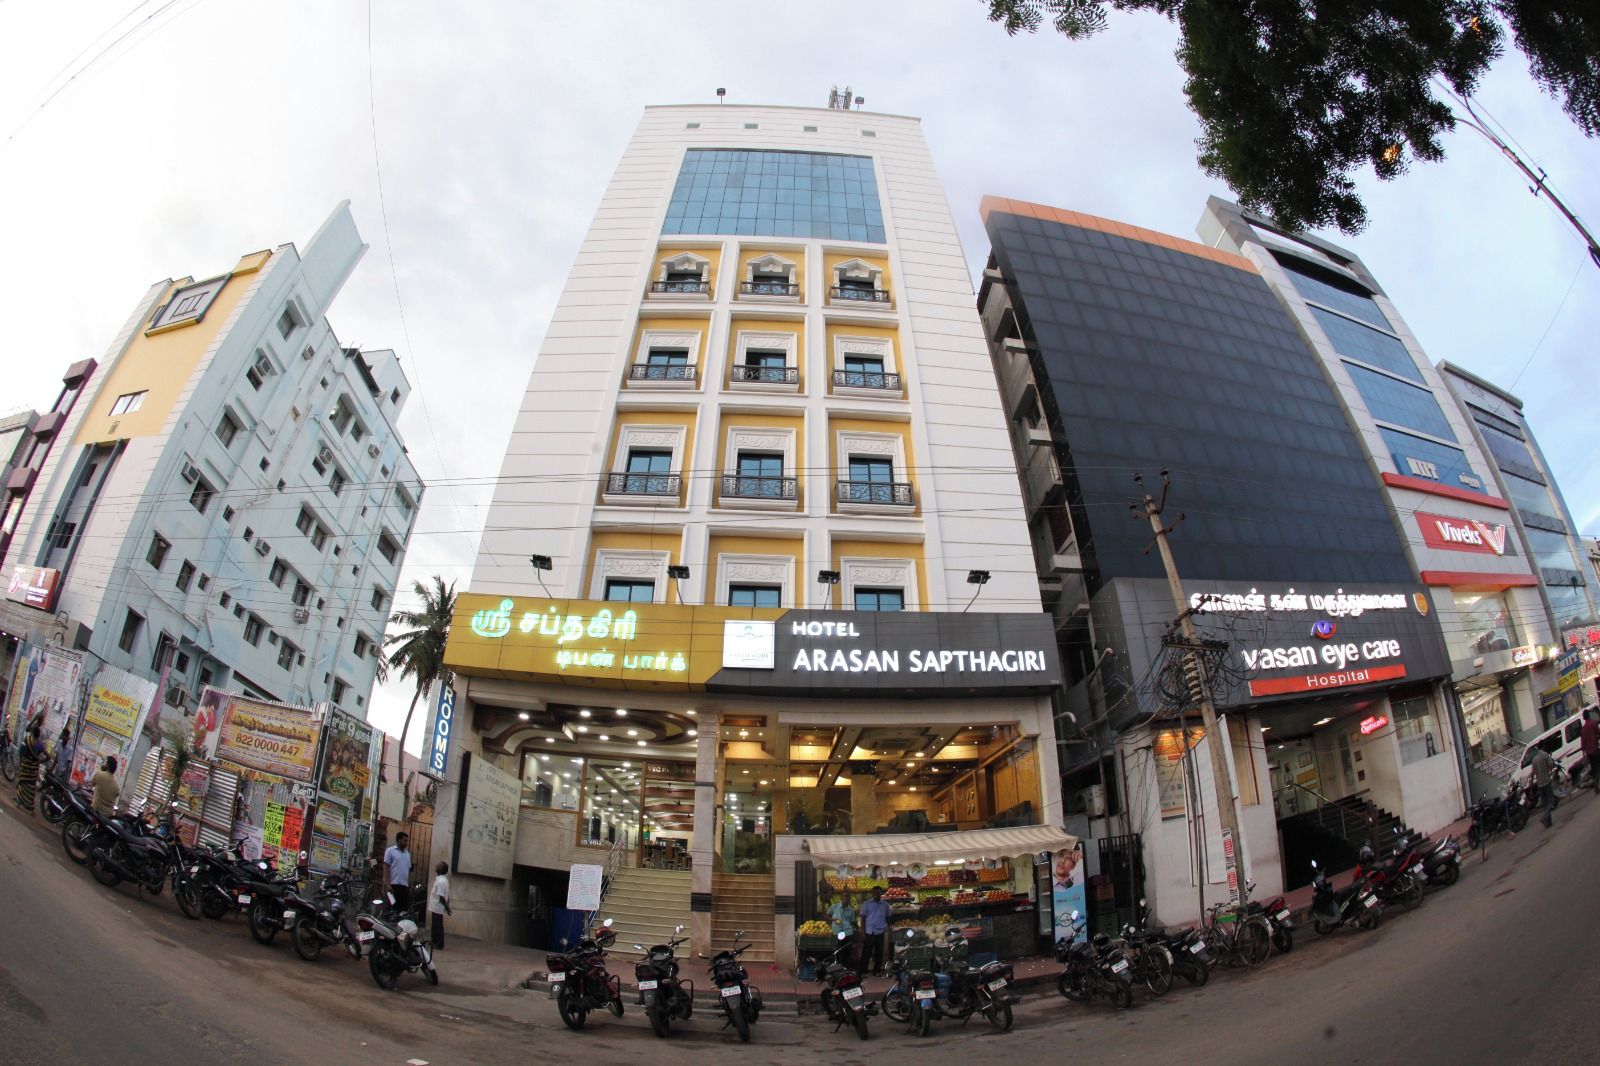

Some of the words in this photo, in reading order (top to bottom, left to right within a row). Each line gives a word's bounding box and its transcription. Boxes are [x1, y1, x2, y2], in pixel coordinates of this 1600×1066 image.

[1435, 520, 1482, 545] Viveks
[792, 621, 860, 637] HOTEL
[793, 648, 900, 672] ARASAN
[908, 650, 1046, 673] SAPTHAGIRI
[1241, 644, 1318, 670] vasan
[1321, 640, 1360, 670] eye
[1361, 638, 1401, 660] care
[1306, 669, 1370, 688] Hospital
[433, 686, 453, 769] ROOMS
[235, 732, 254, 746] 822
[254, 738, 279, 753] 0000
[280, 744, 299, 757] 447
